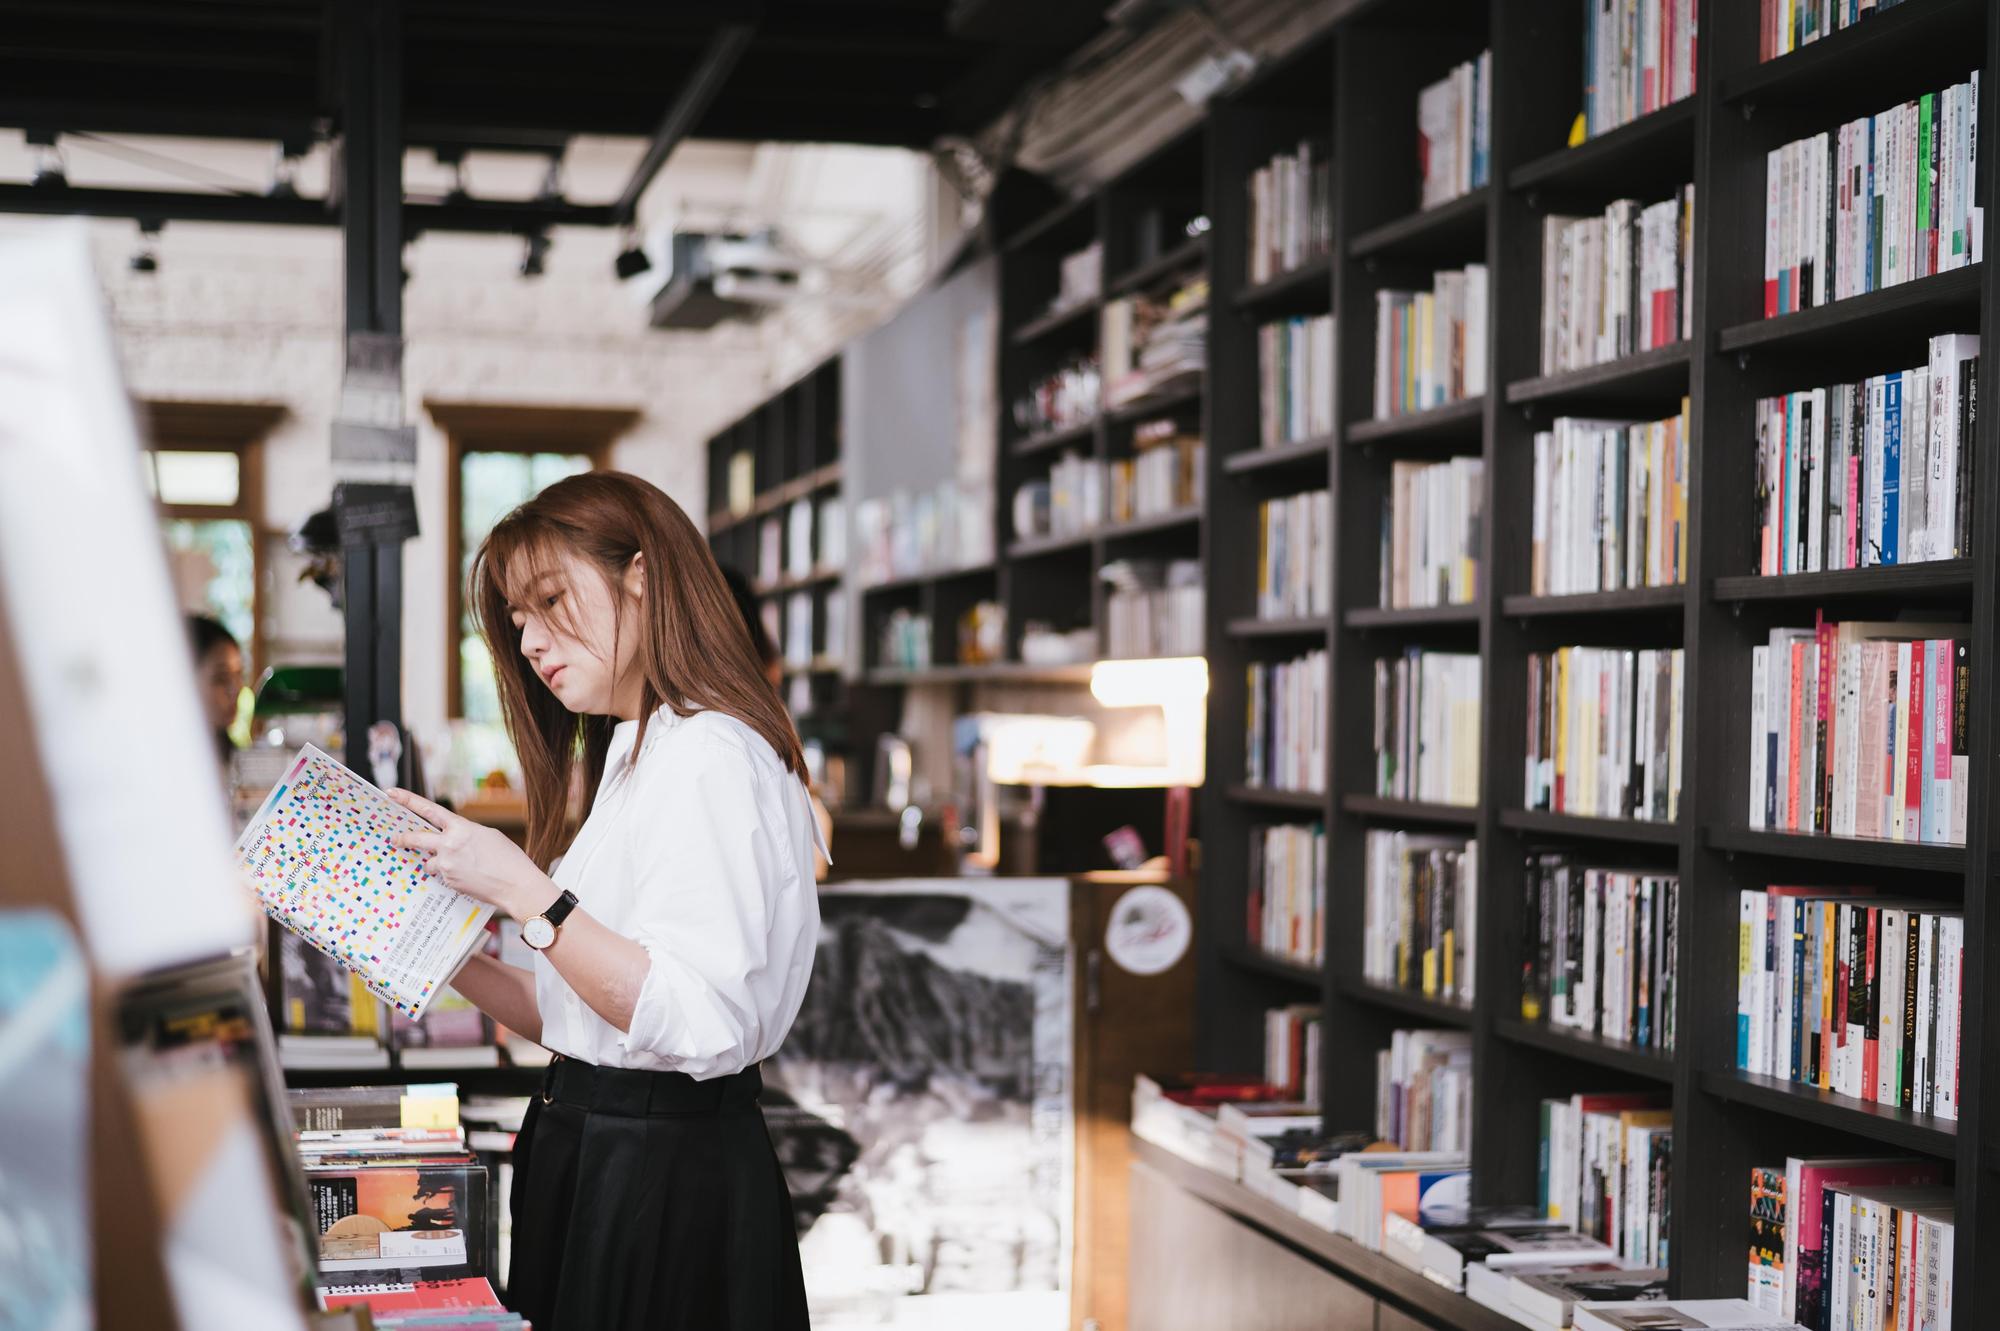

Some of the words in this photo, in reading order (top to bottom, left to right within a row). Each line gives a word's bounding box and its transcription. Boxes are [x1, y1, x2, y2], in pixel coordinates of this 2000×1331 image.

[264, 824, 272, 835] of
[250, 850, 275, 879] looking
[285, 840, 319, 885] introduction
[316, 831, 325, 840] to
[289, 880, 309, 905] viual
[307, 854, 328, 881] culture
[367, 983, 396, 1003] edition
